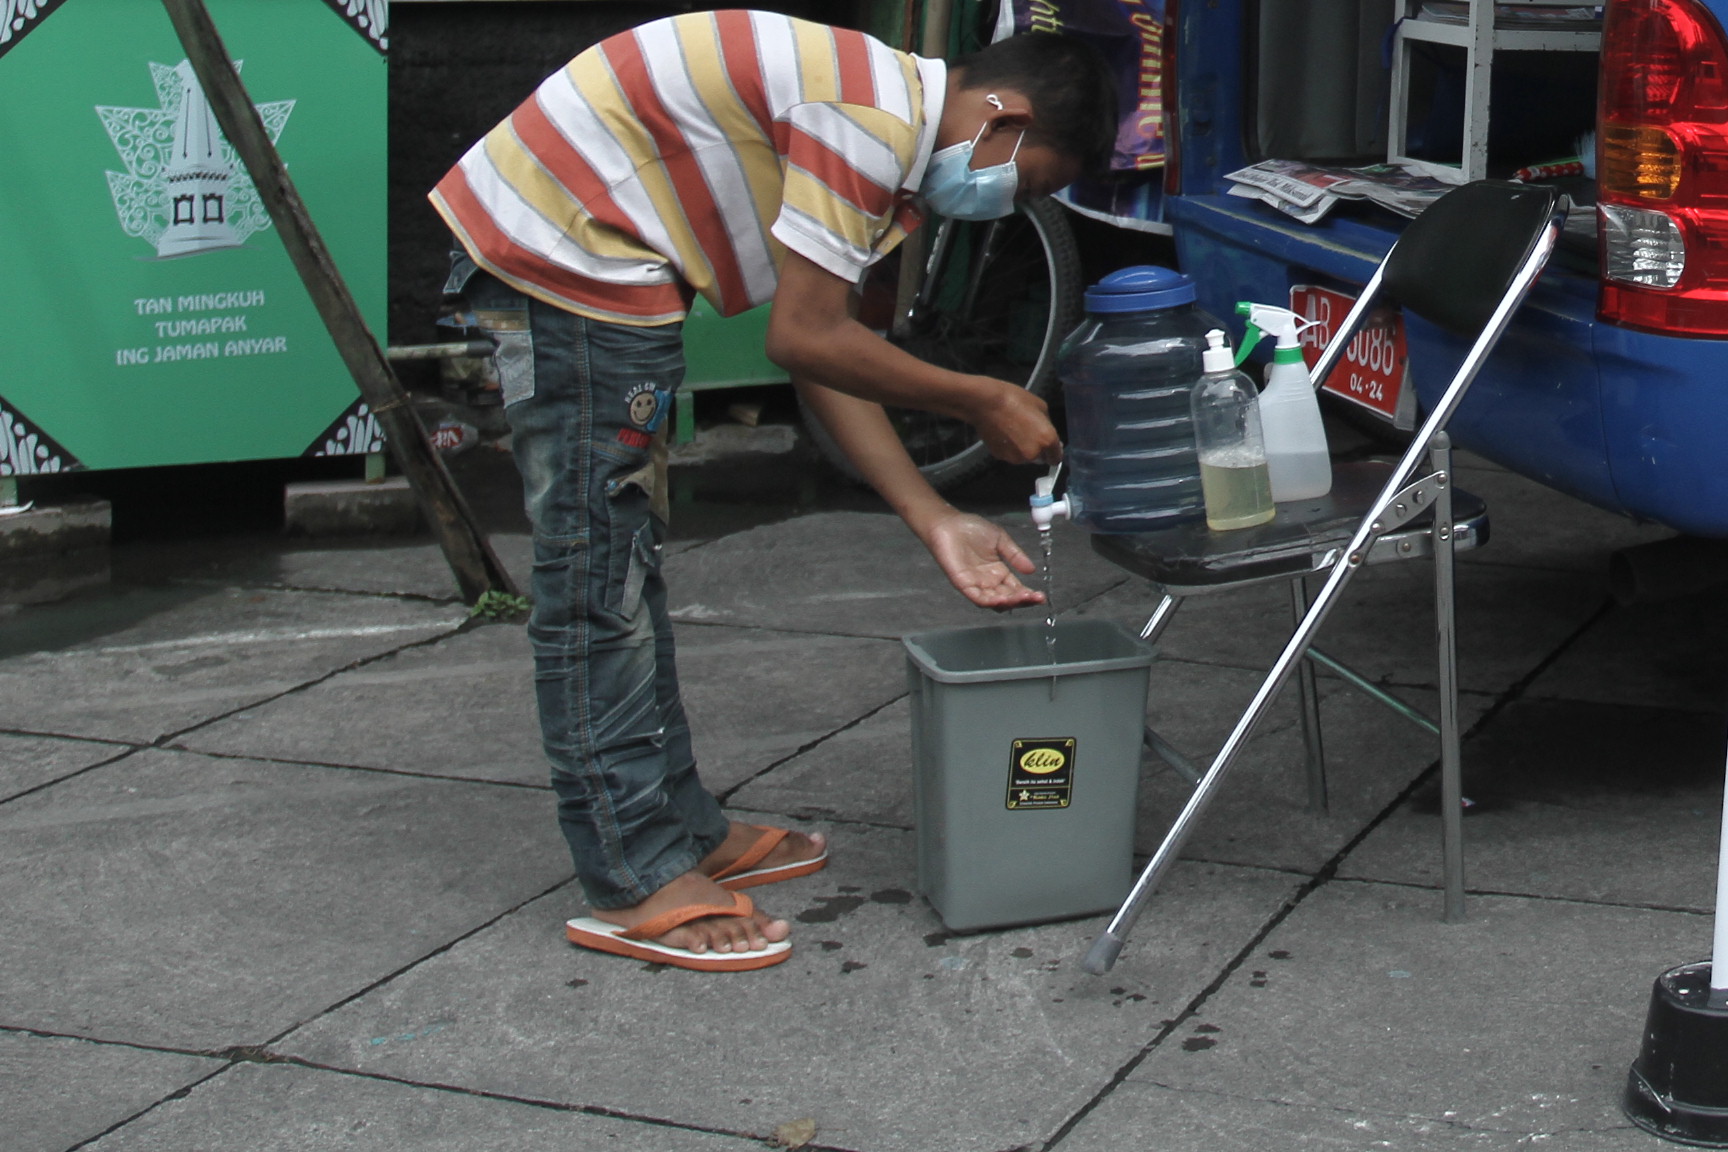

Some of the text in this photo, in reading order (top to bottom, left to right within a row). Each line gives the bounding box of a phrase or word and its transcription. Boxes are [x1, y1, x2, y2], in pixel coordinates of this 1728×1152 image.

[134, 290, 265, 315] TAN MINGKUH
[155, 315, 247, 338] TUMAPAK
[1301, 294, 1330, 350] AB
[116, 336, 287, 366] ING JAMAN ANYAR
[1024, 752, 1061, 768] klin
